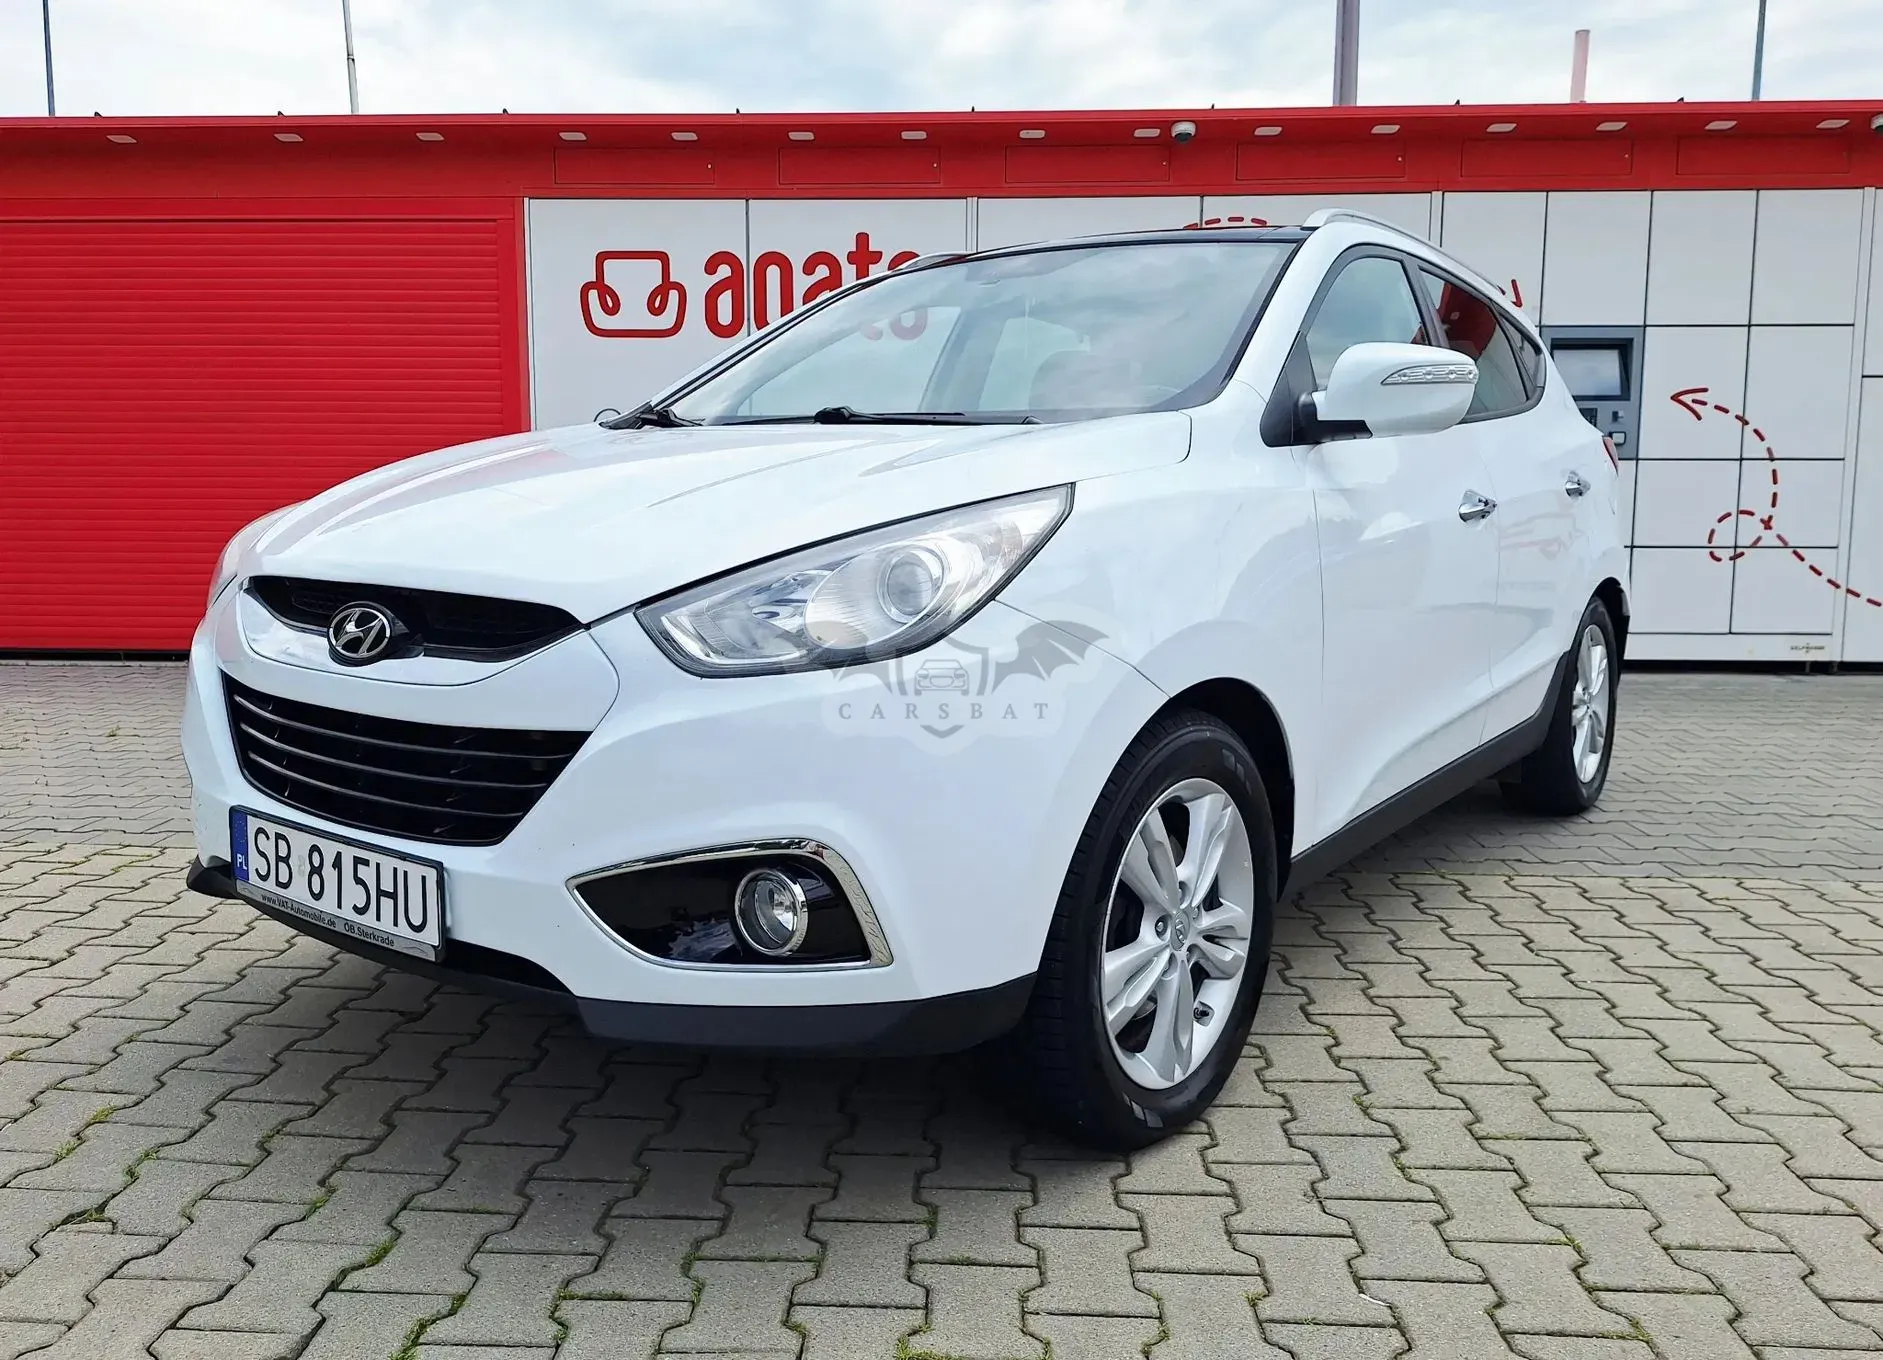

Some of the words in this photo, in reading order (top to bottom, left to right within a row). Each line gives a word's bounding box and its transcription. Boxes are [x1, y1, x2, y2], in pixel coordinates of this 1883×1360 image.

[236, 853, 248, 871] PL
[254, 826, 293, 890] SB
[307, 843, 428, 934] 815HU
